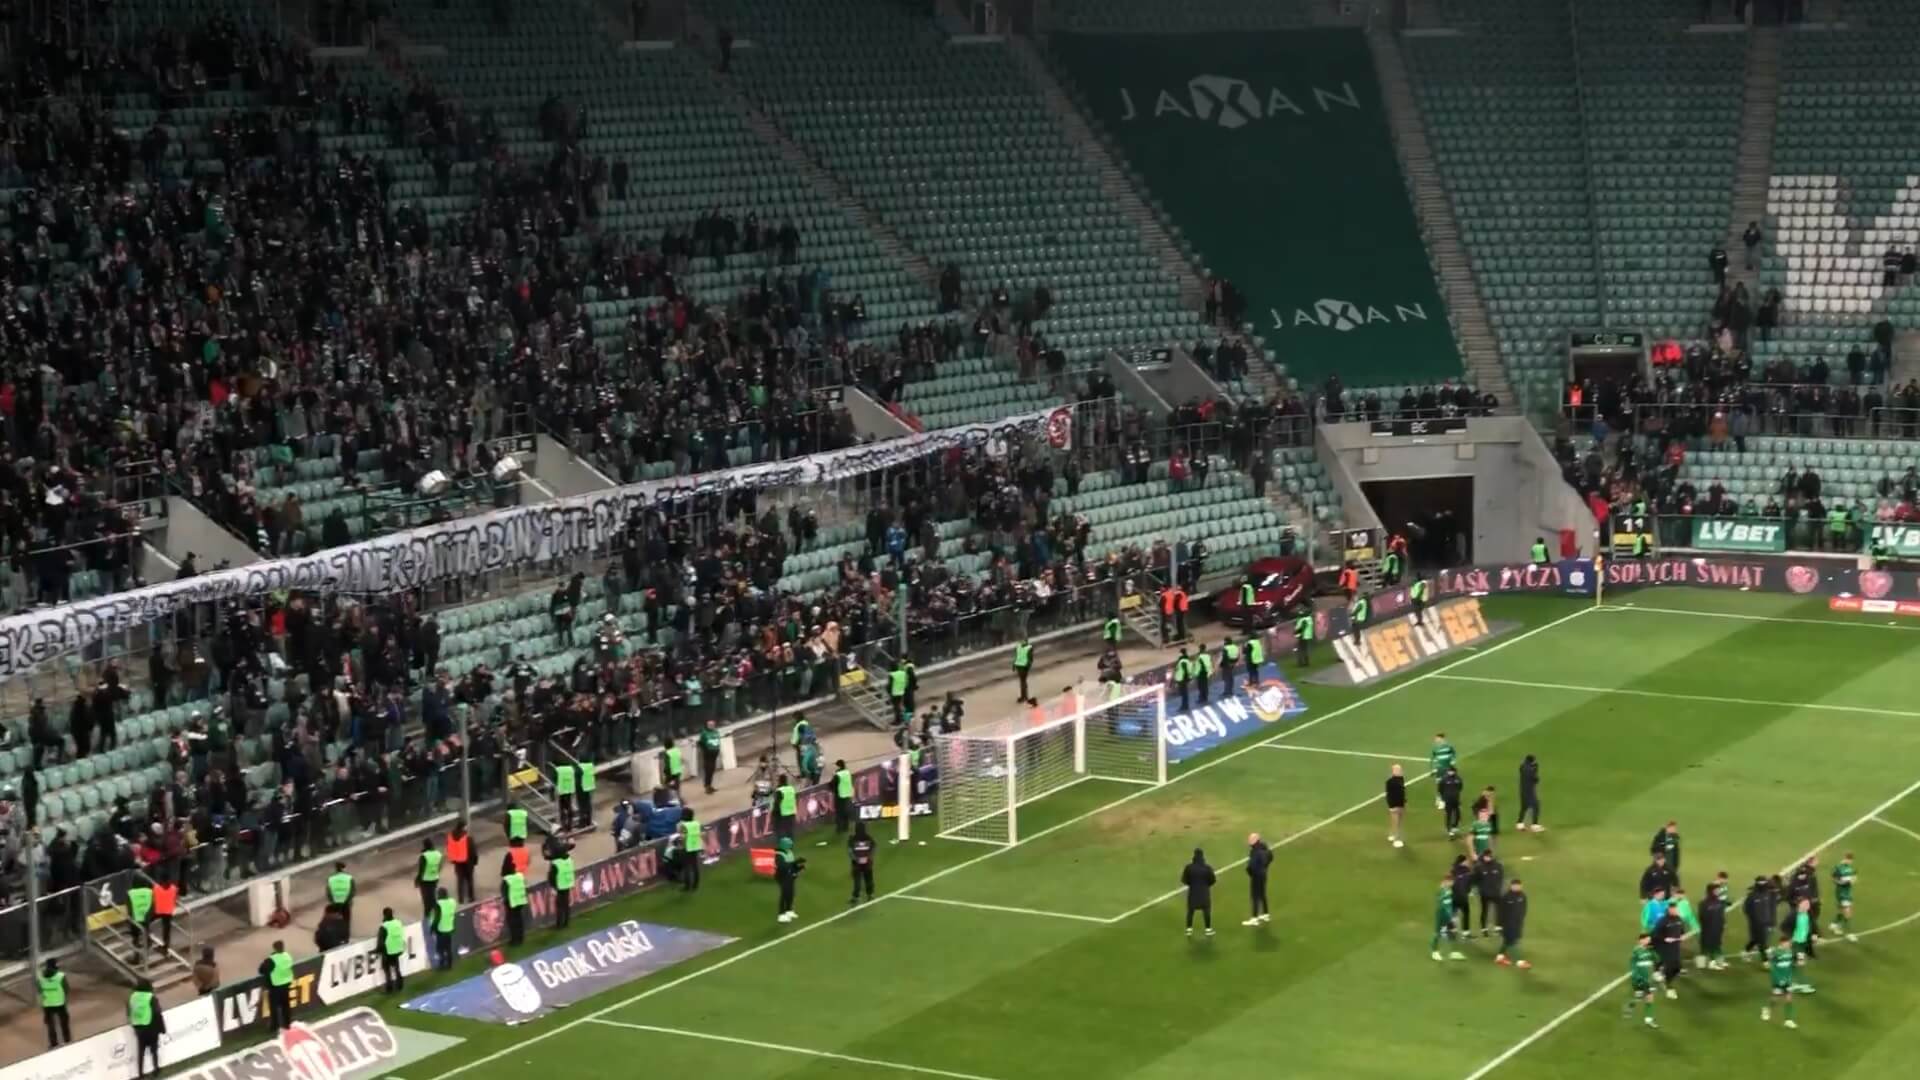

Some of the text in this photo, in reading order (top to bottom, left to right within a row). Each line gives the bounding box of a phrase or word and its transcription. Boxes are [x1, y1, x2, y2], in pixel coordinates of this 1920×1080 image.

[1270, 298, 1428, 331] JAXAN
[1623, 518, 1644, 533] 11
[1217, 695, 1249, 724] W
[99, 882, 113, 907] 6
[533, 920, 654, 989] Bank Polski
